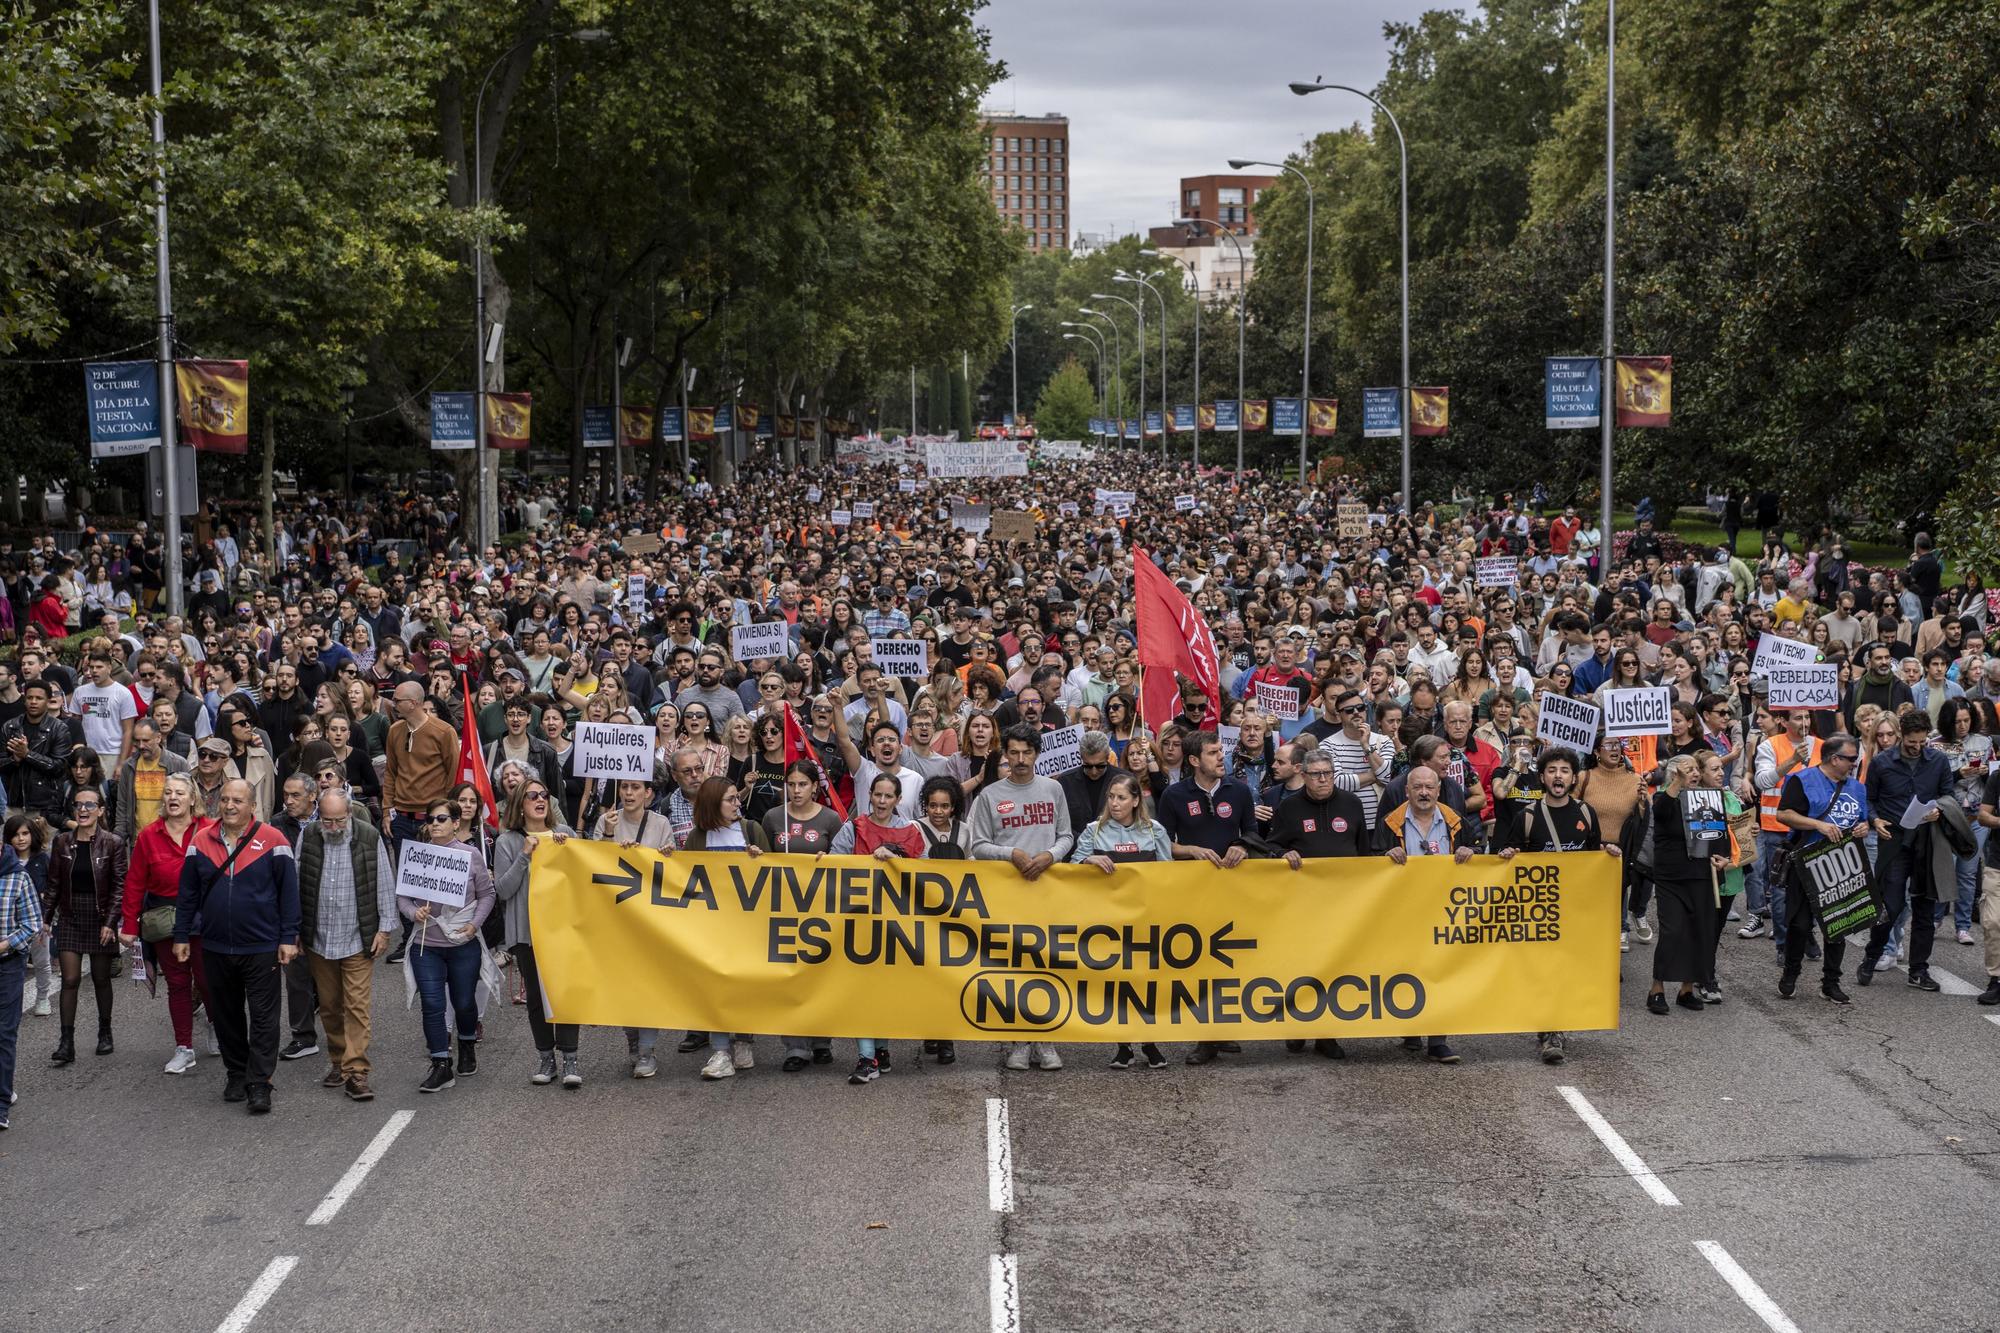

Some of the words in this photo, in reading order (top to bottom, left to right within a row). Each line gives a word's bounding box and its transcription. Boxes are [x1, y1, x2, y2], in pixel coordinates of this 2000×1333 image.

[93, 371, 101, 380] 12
[102, 370, 116, 379] DE
[93, 380, 140, 391] OCTUBRE
[1552, 384, 1568, 393] DÍA
[95, 397, 116, 409] DÍA
[118, 398, 134, 408] DE
[136, 397, 150, 407] LA
[1552, 403, 1596, 412] NACIONAL
[96, 410, 134, 422] FIESTA
[97, 421, 157, 434] NACIONAL
[1344, 526, 1364, 535] CAZA
[738, 626, 772, 640] VIVIENDA
[741, 644, 768, 658] Abusos
[769, 643, 782, 656] NO.
[876, 642, 921, 656] DERECHO
[1771, 641, 1784, 654] UN
[1784, 643, 1806, 660] TECHO
[880, 664, 886, 675] A
[887, 662, 922, 675] TECHO.
[1756, 655, 1766, 667] ES
[1769, 670, 1837, 685] REBELDES
[1257, 685, 1297, 701] DERECHO
[1769, 689, 1792, 704] SIN
[1796, 689, 1837, 704] CASA!
[1263, 697, 1297, 712] TECHO
[1543, 695, 1595, 725] ¡DERECHO
[1608, 692, 1668, 723] Justicia!
[582, 726, 648, 750] Alquileres,
[1540, 718, 1549, 734] A
[1551, 720, 1591, 747] TECHO!
[584, 752, 623, 773] justos
[626, 755, 646, 773] YA.
[1034, 751, 1082, 776] ACCESIBLES
[1023, 801, 1054, 815] NIÑA
[1001, 814, 1054, 829] POLACA
[404, 846, 435, 869] ¡Castigar
[434, 854, 469, 873] productos
[1805, 841, 1863, 892] TODO
[402, 868, 439, 891] financieros
[439, 876, 466, 896] tóxicos!
[1515, 865, 1560, 884] POR
[651, 861, 719, 911] LA
[728, 865, 990, 919] VIVIENDA
[1449, 885, 1560, 906] CIUDADES
[1818, 887, 1840, 908] POR
[1837, 872, 1867, 900] HACER
[1444, 906, 1458, 925] Y
[1464, 903, 1560, 925] PUEBLOS
[1433, 922, 1560, 945] HABITABLES
[768, 917, 832, 964] ES
[843, 919, 925, 966] UN
[939, 921, 1203, 970] DERECHO
[975, 978, 1061, 1024] NO
[1077, 979, 1158, 1025] UN
[1170, 973, 1426, 1026] NEGOCIO
